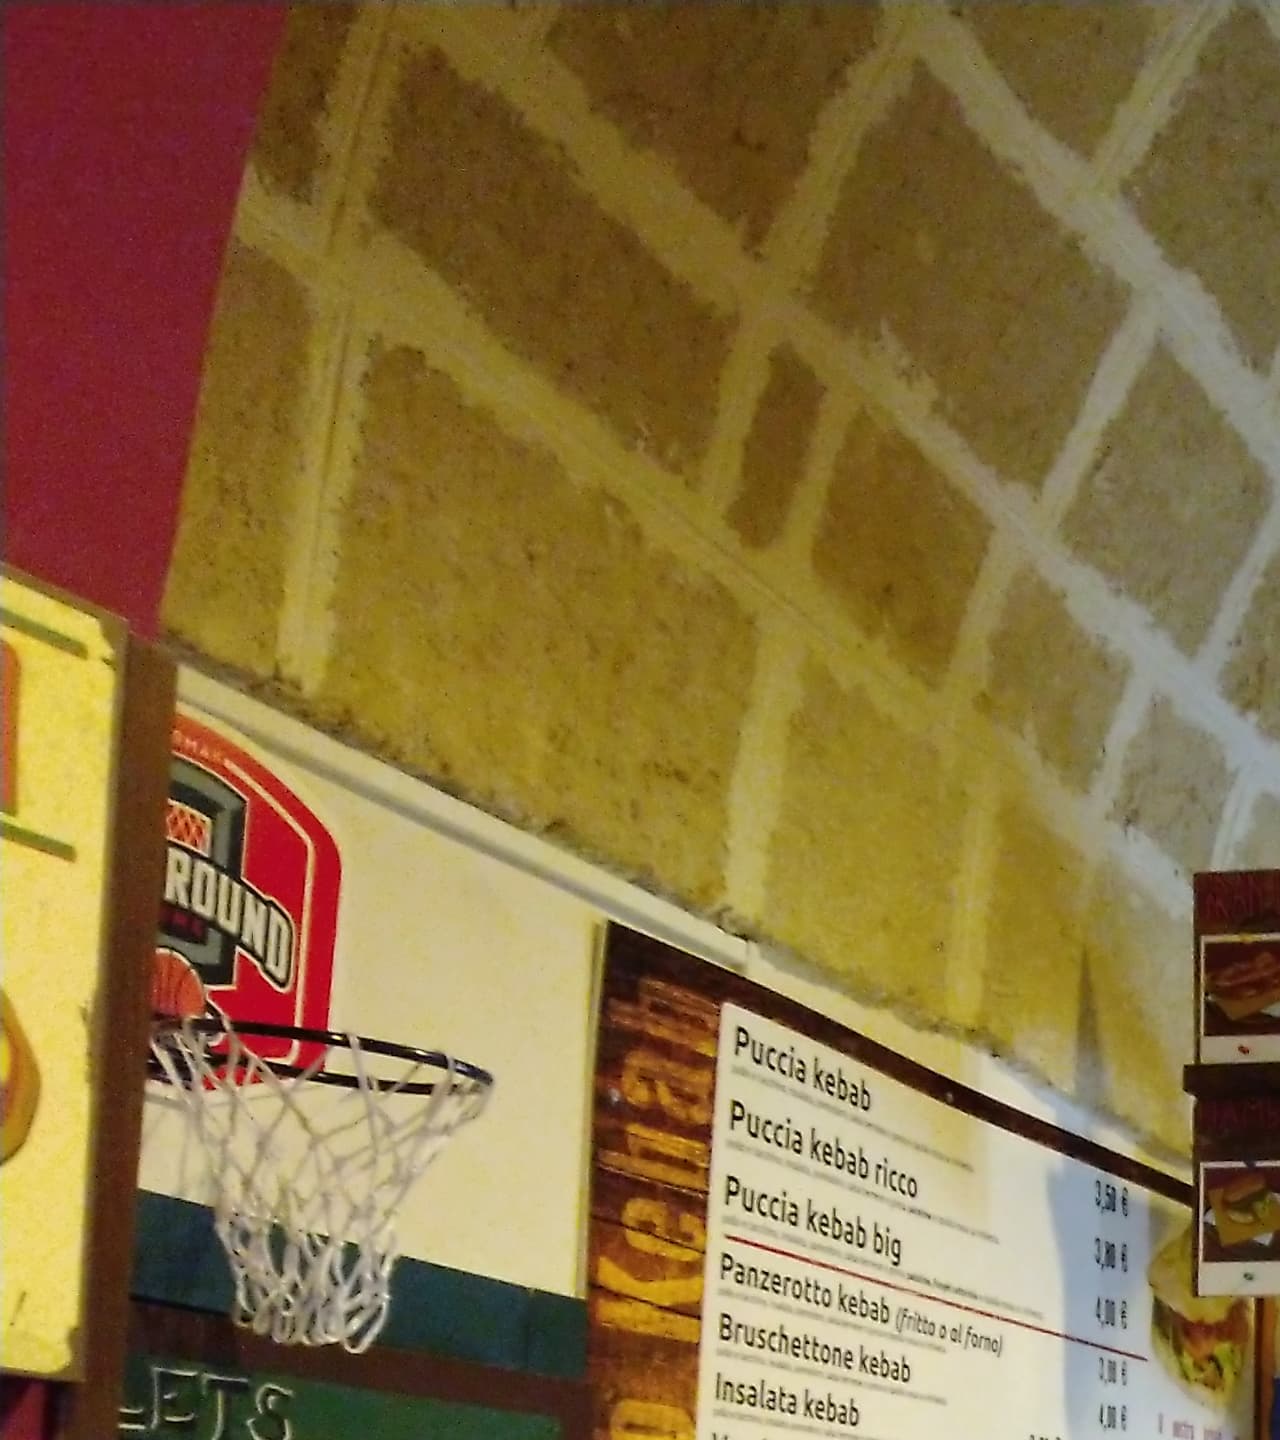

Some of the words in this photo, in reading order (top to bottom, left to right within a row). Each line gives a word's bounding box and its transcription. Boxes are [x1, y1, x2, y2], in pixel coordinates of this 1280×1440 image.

[734, 1026, 807, 1083] Puccia
[812, 1056, 872, 1112] kebab
[729, 1099, 803, 1154] Puccia
[809, 1127, 869, 1180] kebab
[875, 1157, 918, 1199] ricco
[723, 1174, 799, 1228] Puccia
[805, 1198, 867, 1249] kebab
[873, 1221, 903, 1267] big
[718, 1312, 854, 1370] Bruschettone
[858, 1344, 912, 1384] kebab
[719, 1251, 832, 1309] Panzerotto
[837, 1282, 891, 1326] kebab
[895, 1304, 936, 1337] (fritto
[938, 1326, 948, 1340] o
[949, 1324, 963, 1344] al
[963, 1325, 1004, 1358] forno)
[714, 1371, 798, 1416] Insalata
[802, 1388, 860, 1427] kebab
